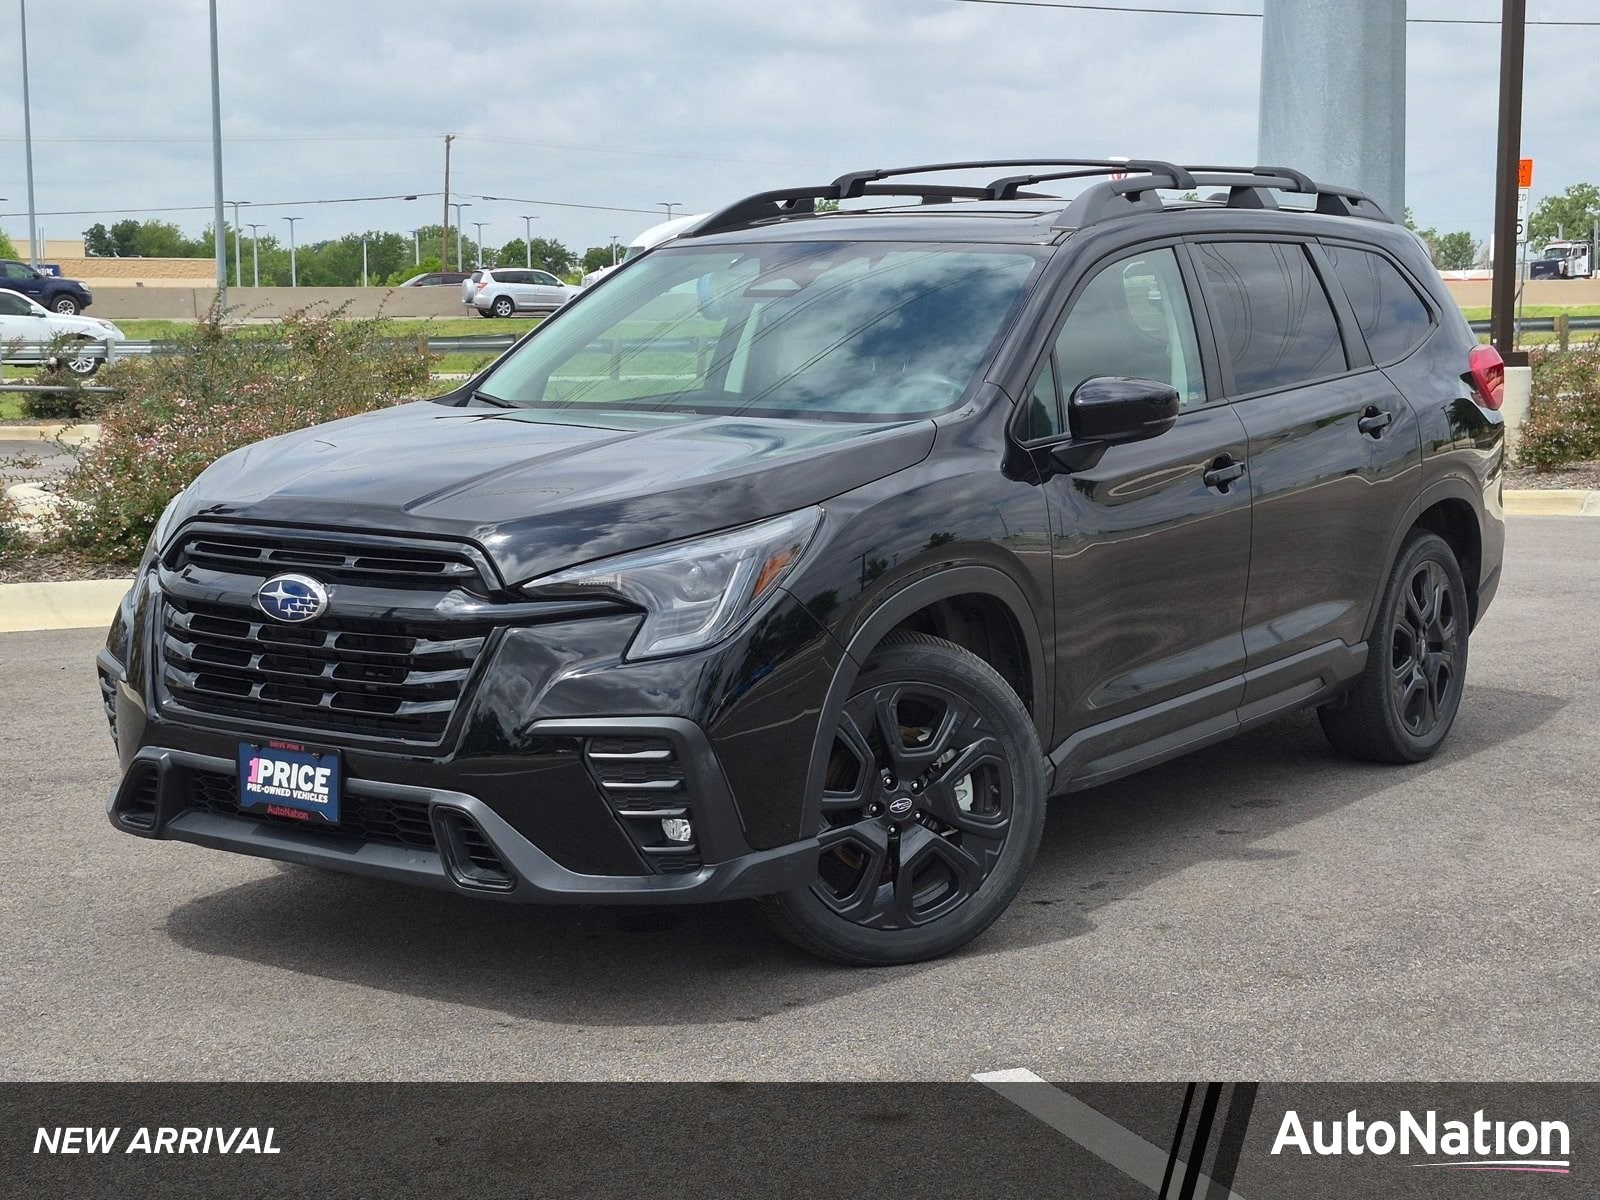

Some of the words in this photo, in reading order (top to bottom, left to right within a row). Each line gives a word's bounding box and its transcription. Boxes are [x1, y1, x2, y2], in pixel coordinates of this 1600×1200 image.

[247, 757, 331, 794] 1PRICE
[246, 782, 291, 797] PRE-OWNED
[292, 790, 329, 804] VEHICLES
[267, 804, 309, 820] AutoNation
